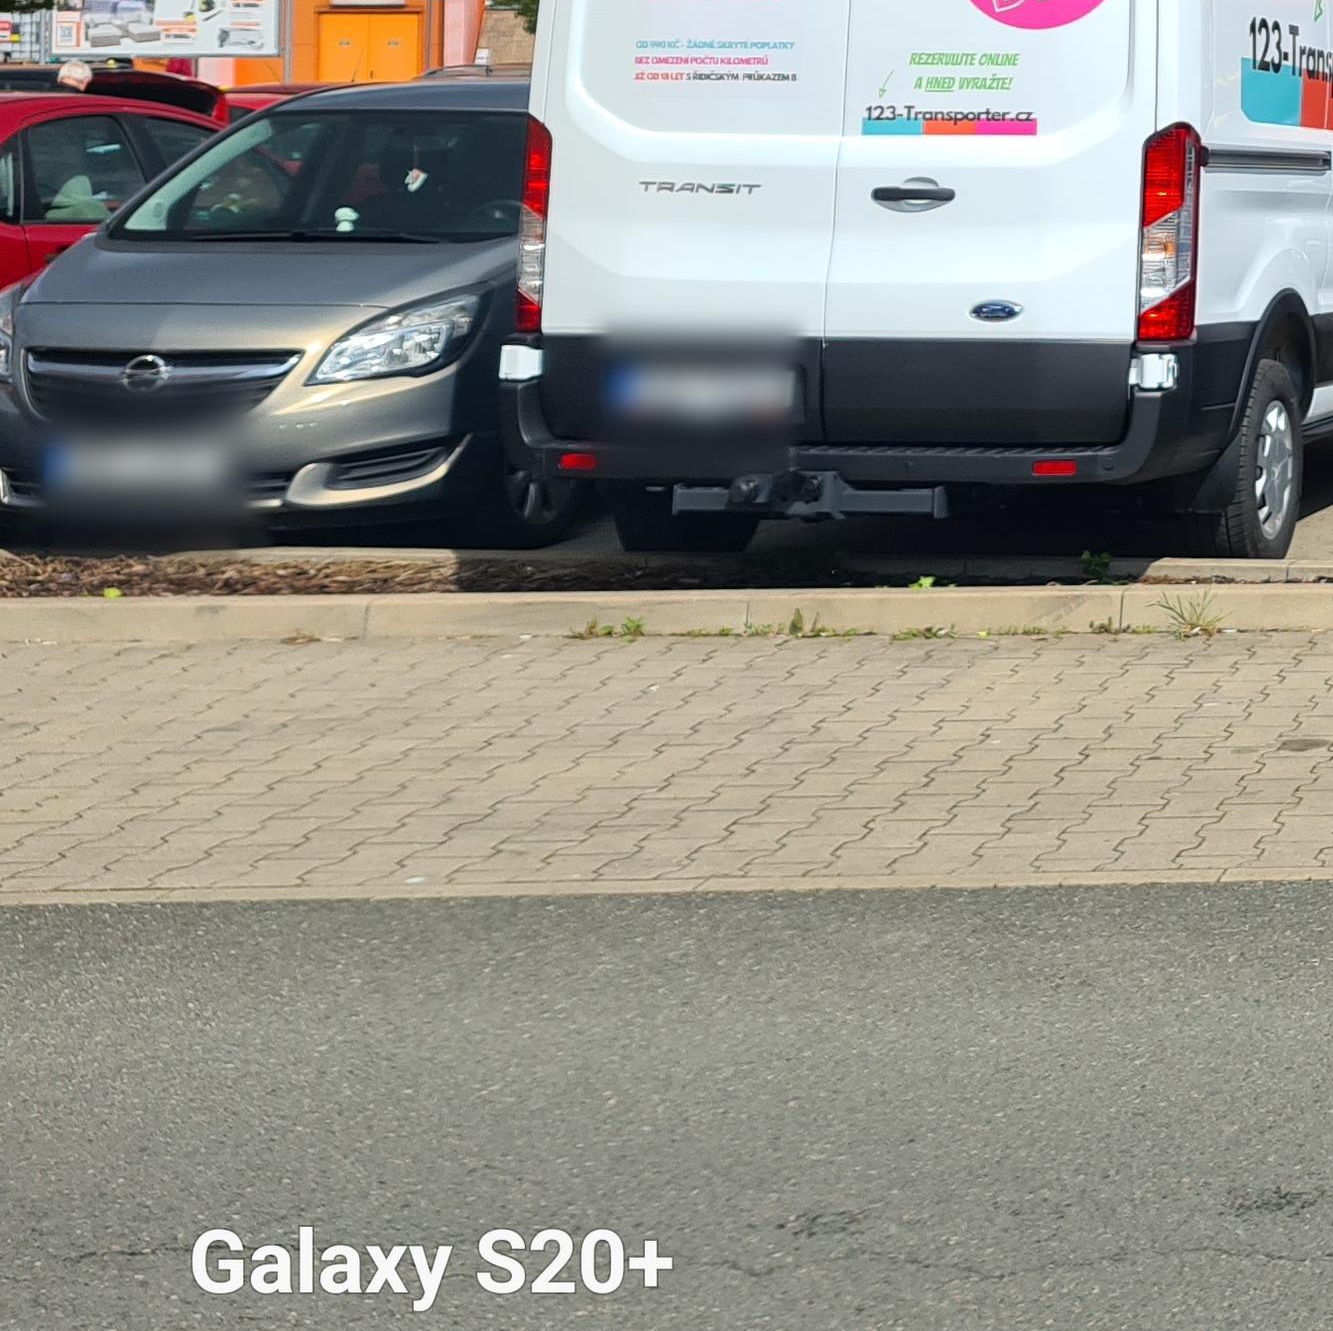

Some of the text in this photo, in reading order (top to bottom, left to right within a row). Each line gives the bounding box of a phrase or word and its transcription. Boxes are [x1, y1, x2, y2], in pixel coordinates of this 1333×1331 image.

[978, 53, 1020, 67] ONLINE
[913, 73, 1014, 91] A HNED VYRAŽTE!
[864, 105, 1034, 126] 123-Transporter.cz
[638, 180, 763, 195] TRANSIT
